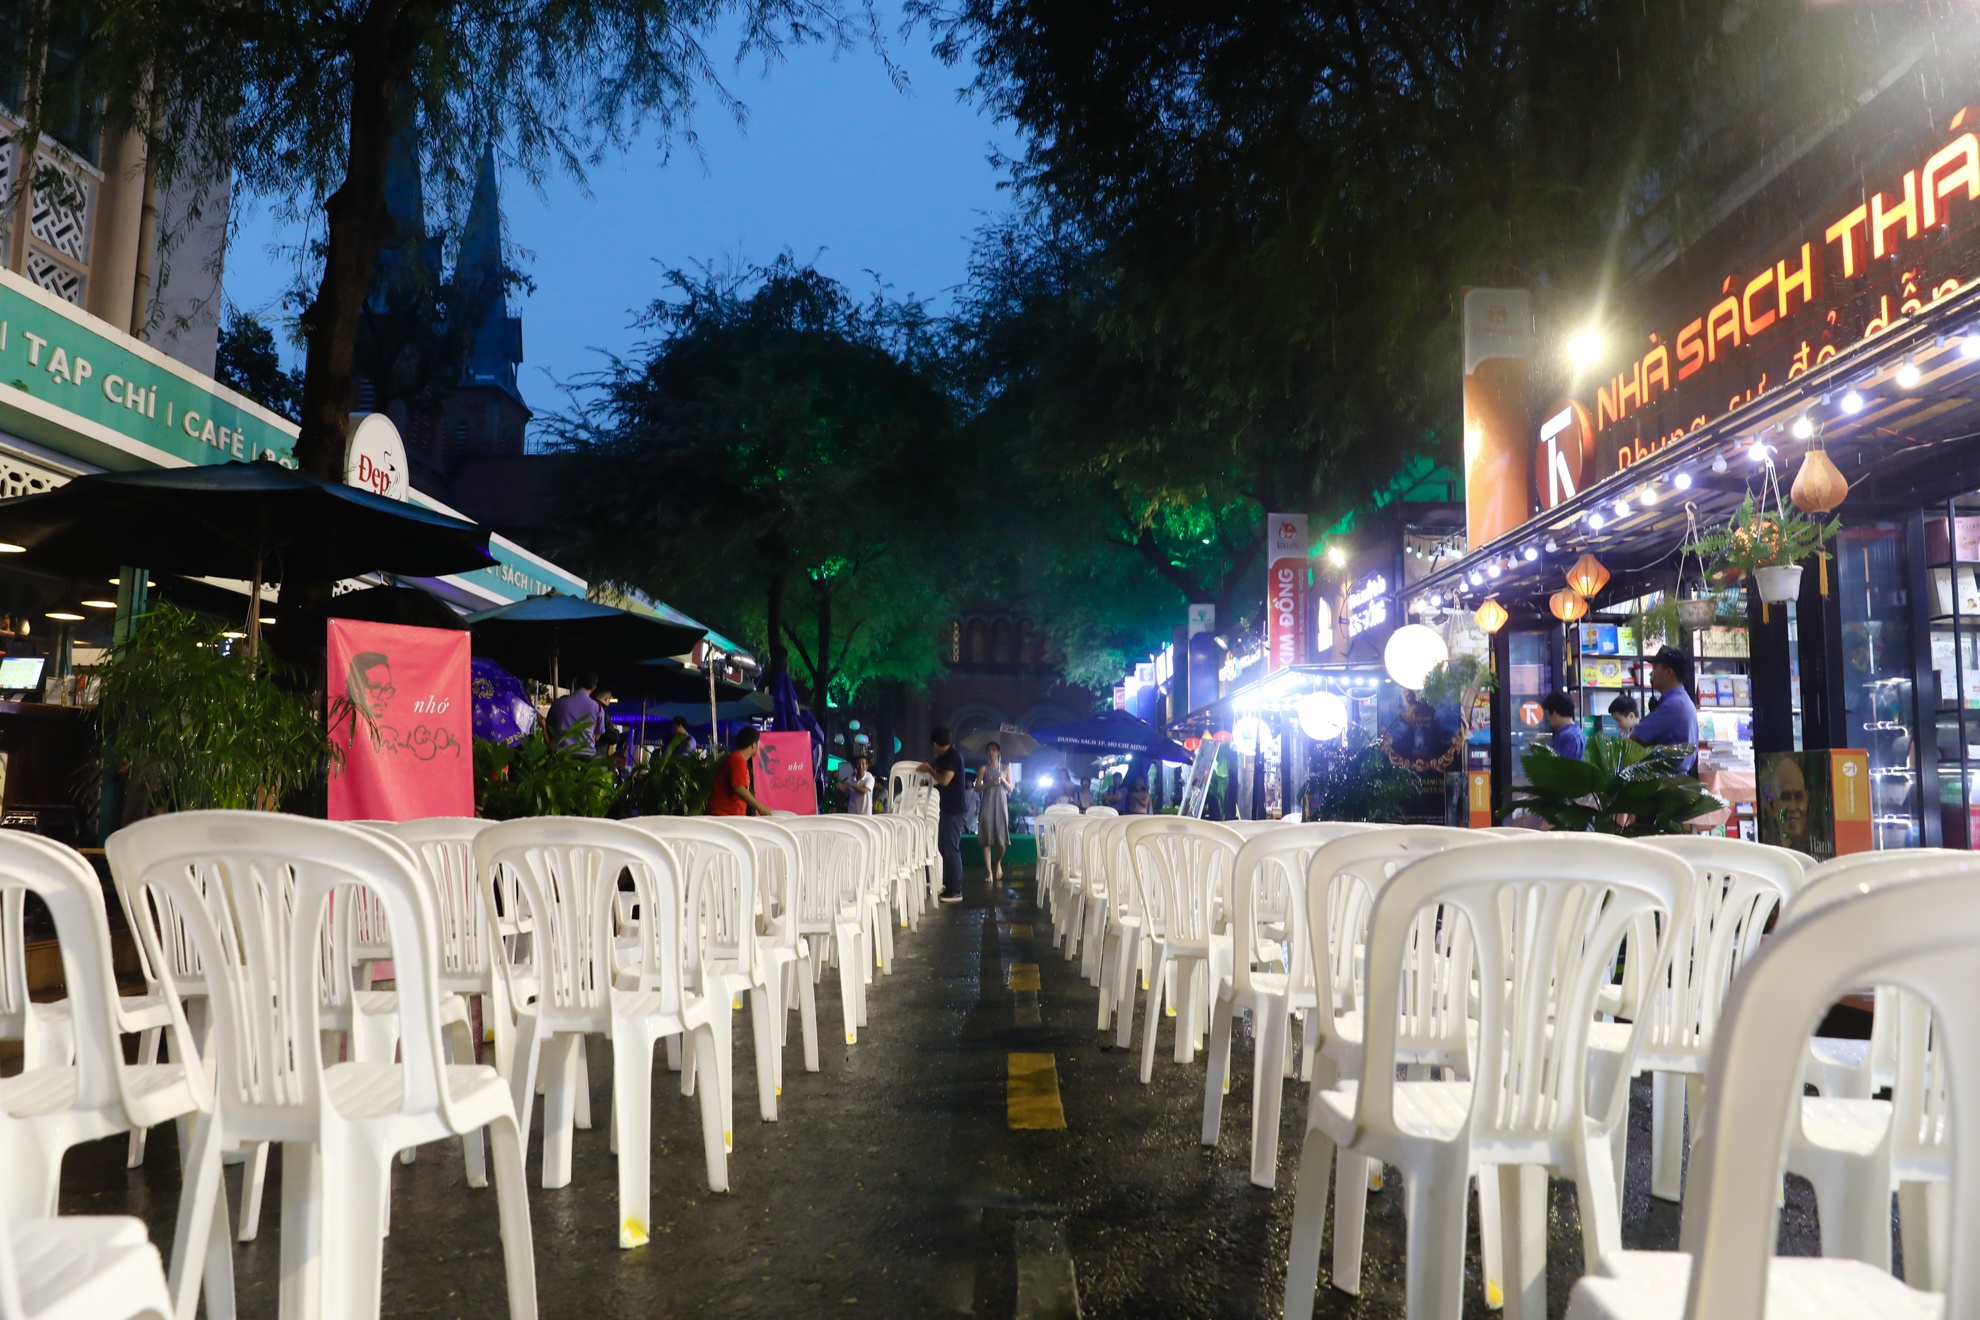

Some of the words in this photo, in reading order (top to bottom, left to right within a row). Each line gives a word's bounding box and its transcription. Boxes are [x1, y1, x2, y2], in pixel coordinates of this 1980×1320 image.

[1597, 332, 1669, 432] NHÀ
[1676, 242, 1812, 381] SÁCH
[22, 331, 92, 386] TẠP
[102, 373, 157, 419] CHÍ
[182, 411, 245, 459] CAFÉ
[501, 563, 528, 591] SÁCH
[1273, 568, 1294, 626] ĐỒNG
[1279, 634, 1294, 669] KIM
[413, 694, 450, 714] nhớ
